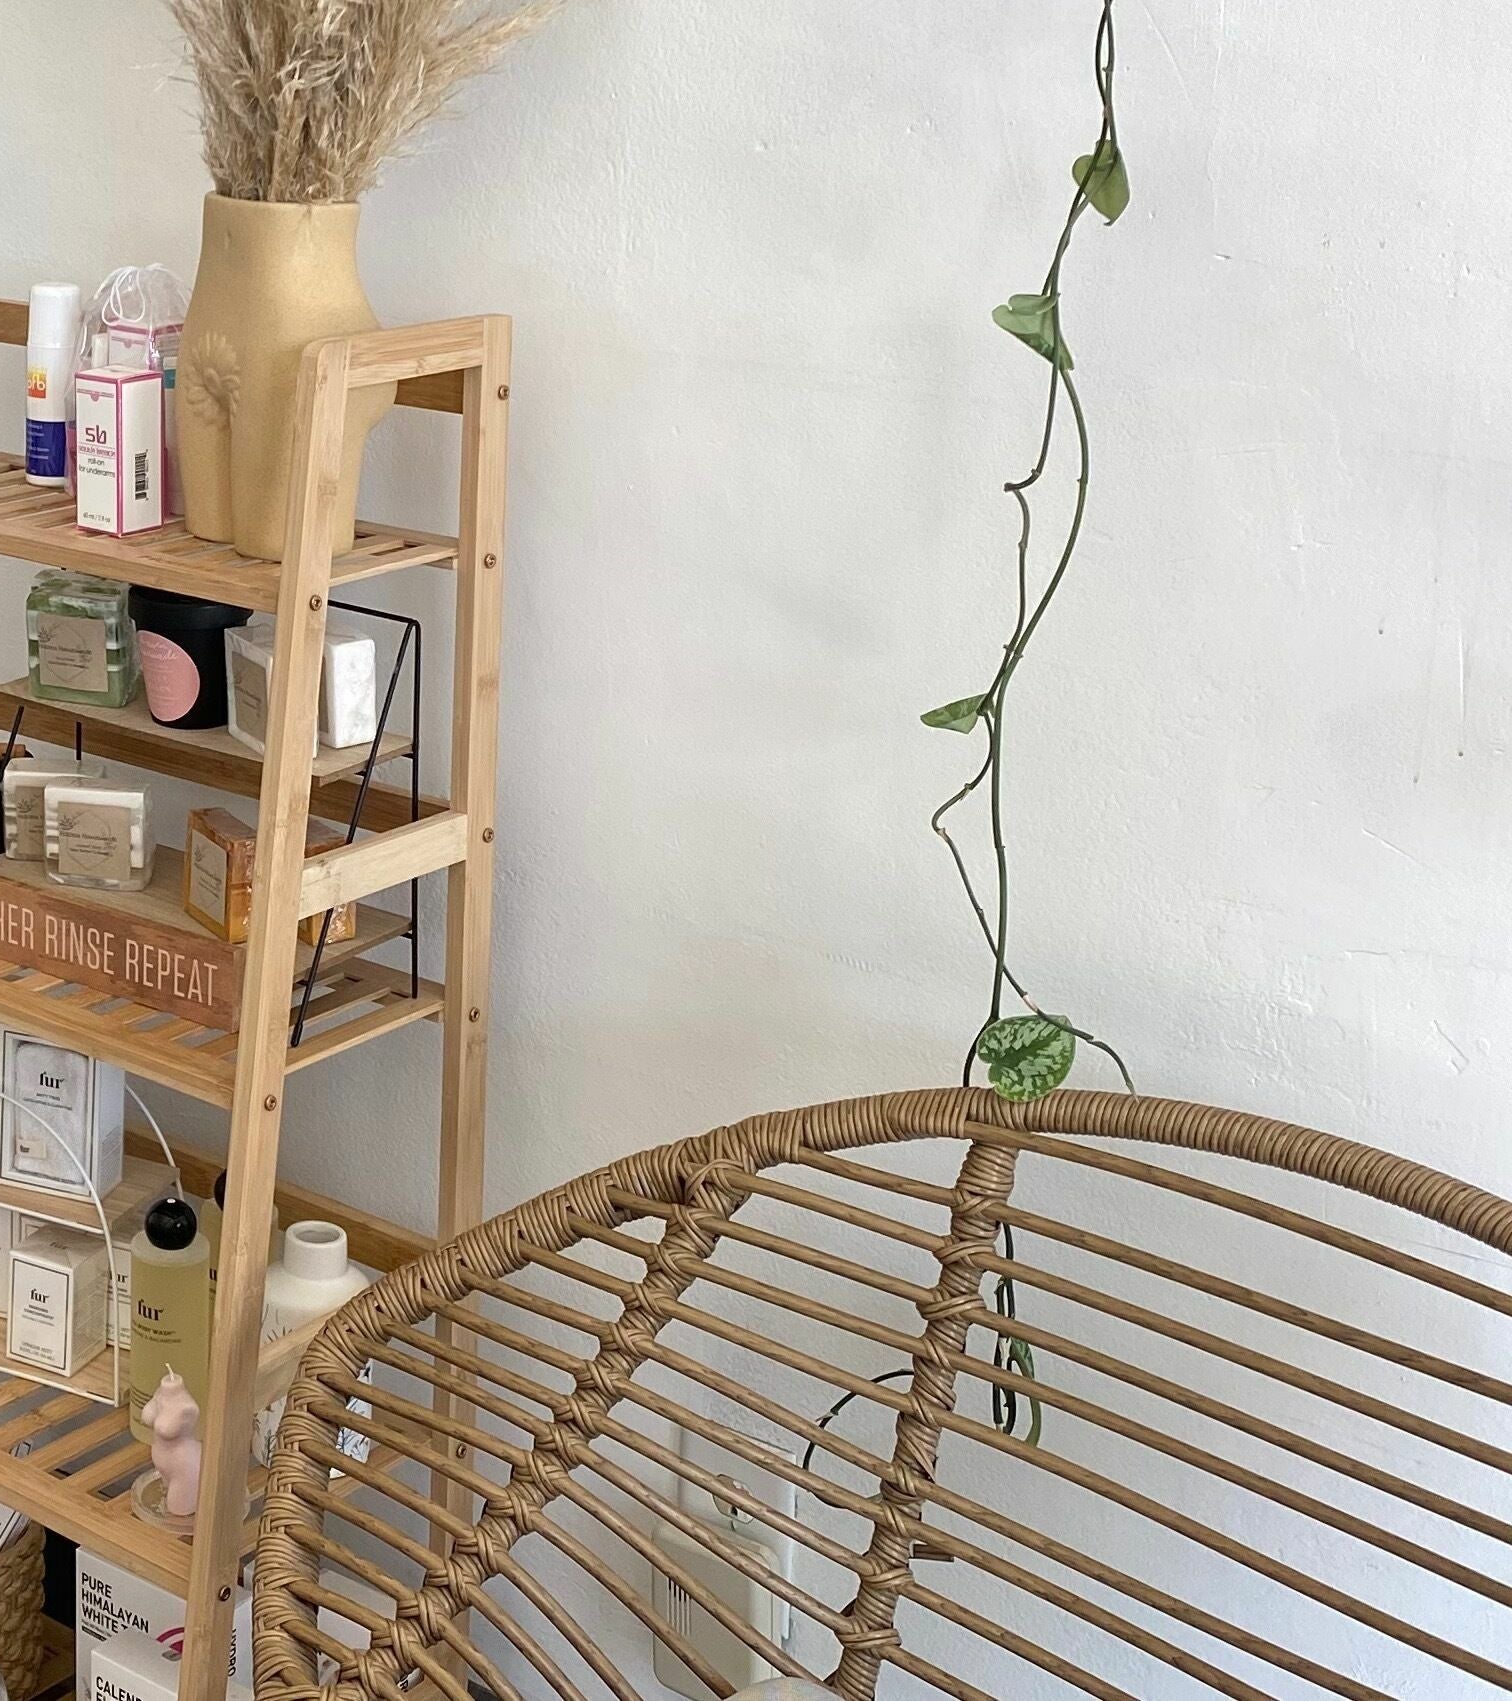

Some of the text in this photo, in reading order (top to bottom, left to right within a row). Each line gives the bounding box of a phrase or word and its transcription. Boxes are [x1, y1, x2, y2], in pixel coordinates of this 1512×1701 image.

[45, 914, 115, 975] RINSE
[125, 939, 218, 1007] REPEAT
[39, 1071, 65, 1089] fur
[30, 1288, 50, 1304] fur
[138, 1298, 164, 1321] fur
[82, 1572, 113, 1599] PURE
[81, 1603, 119, 1633] WHITE
[82, 1588, 149, 1634] HIMALAYAN
[96, 1676, 144, 1701] CALEN
